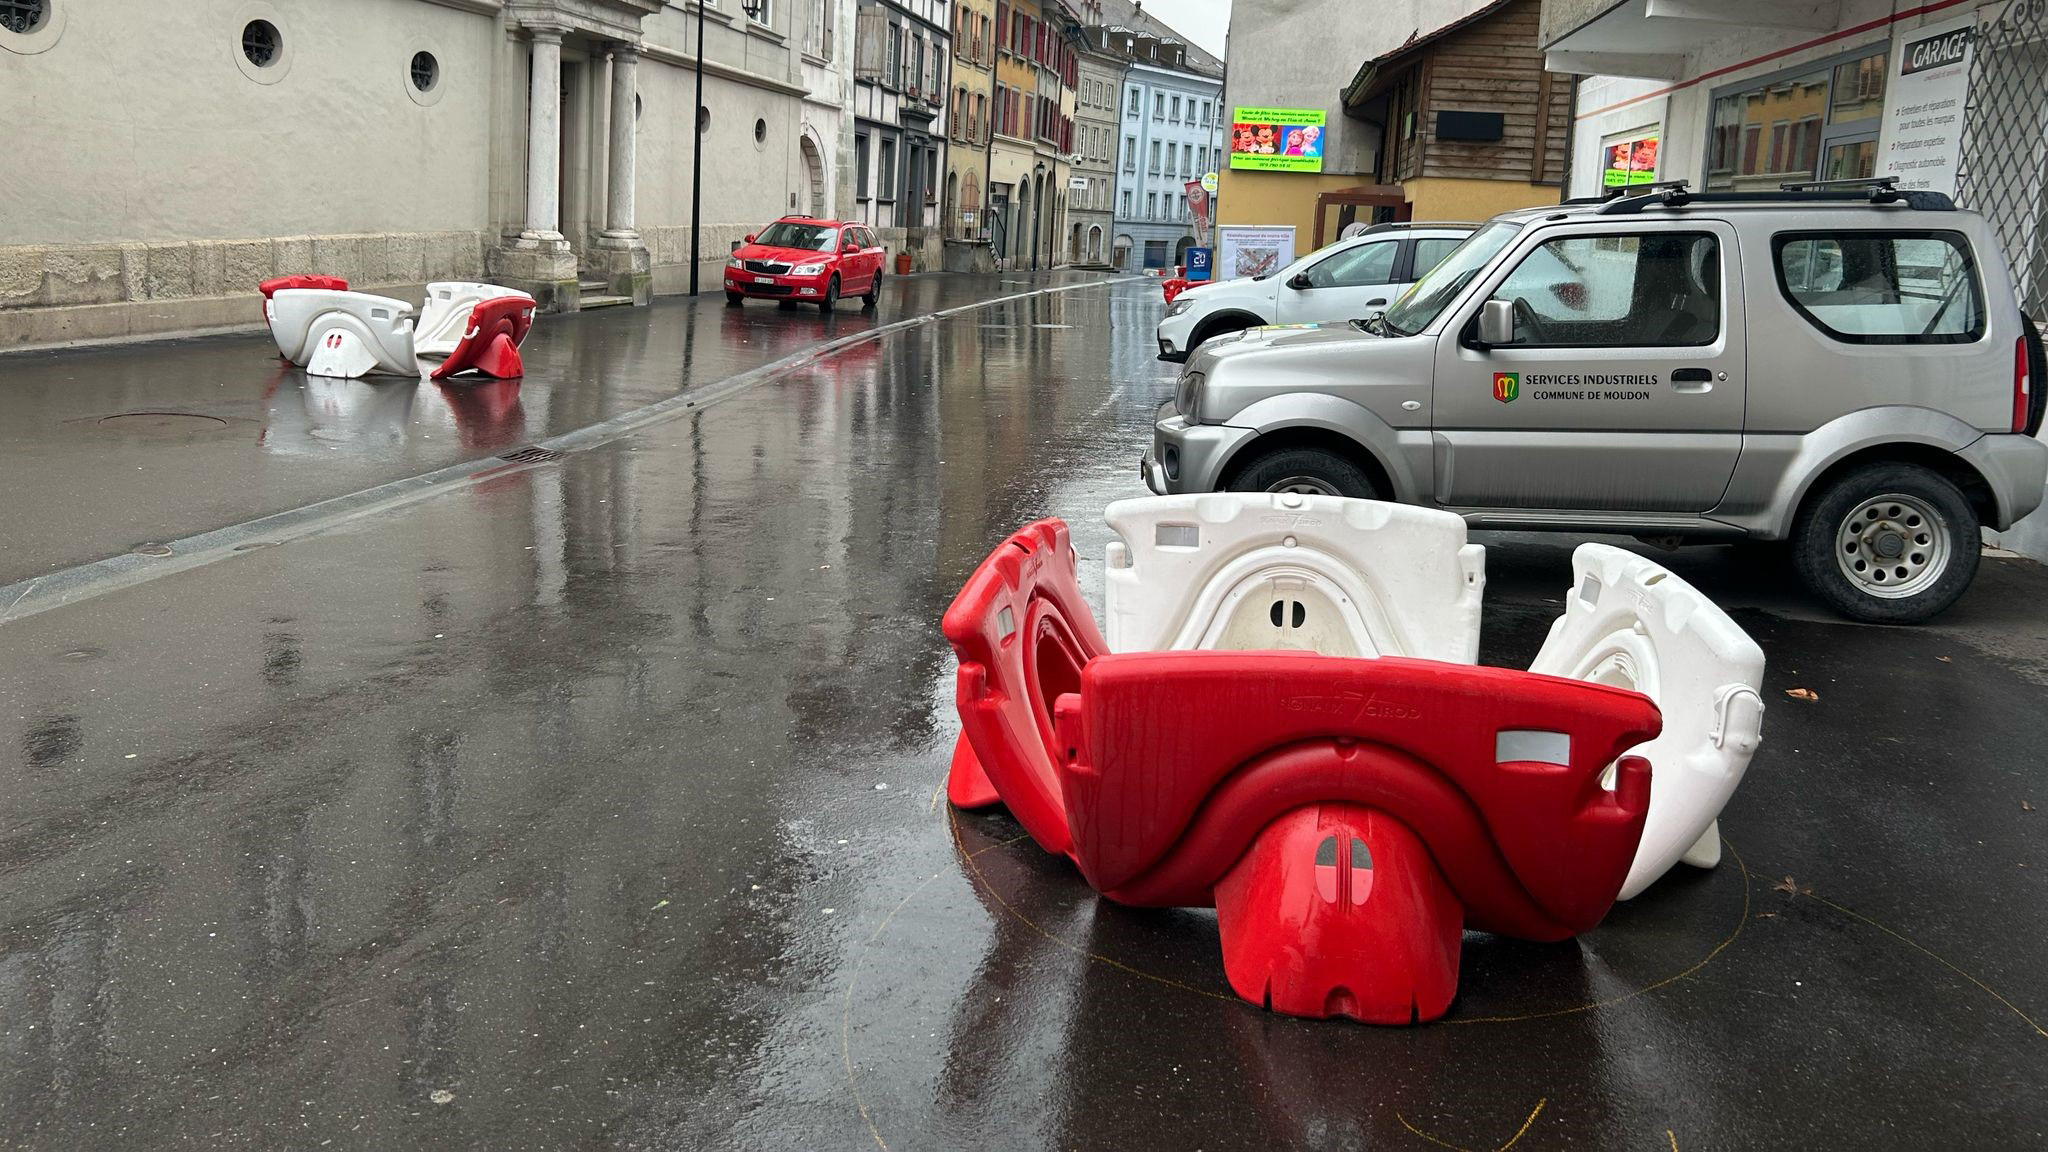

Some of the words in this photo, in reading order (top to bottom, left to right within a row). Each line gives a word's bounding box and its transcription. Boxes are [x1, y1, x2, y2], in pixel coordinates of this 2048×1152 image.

[1911, 32, 1967, 69] GARAGE
[1525, 374, 1580, 385] SERVICES
[1583, 374, 1658, 385] INDUSTRIELS
[1533, 390, 1585, 400] COMMUNE
[1587, 390, 1601, 400] DE
[1603, 390, 1650, 400] MOUDON
